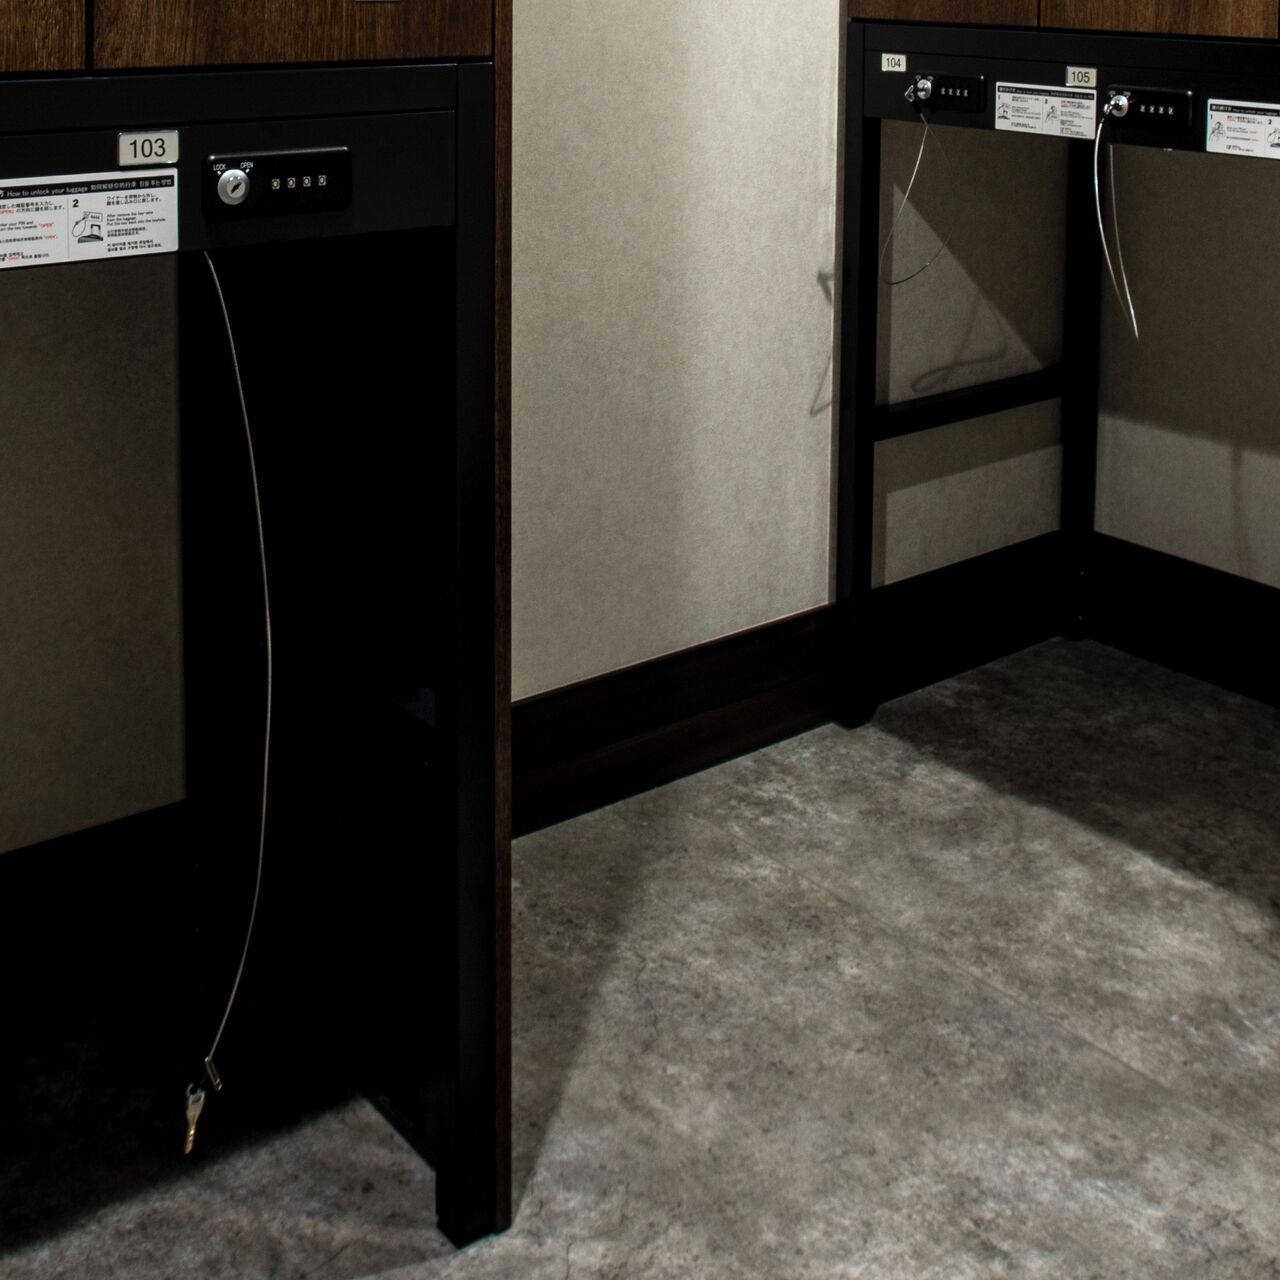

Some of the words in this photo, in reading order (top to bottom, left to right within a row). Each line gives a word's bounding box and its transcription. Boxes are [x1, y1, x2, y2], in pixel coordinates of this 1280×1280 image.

[886, 57, 902, 68] 104
[1071, 71, 1090, 84] 105
[129, 138, 166, 158] 103
[72, 199, 79, 208] 2
